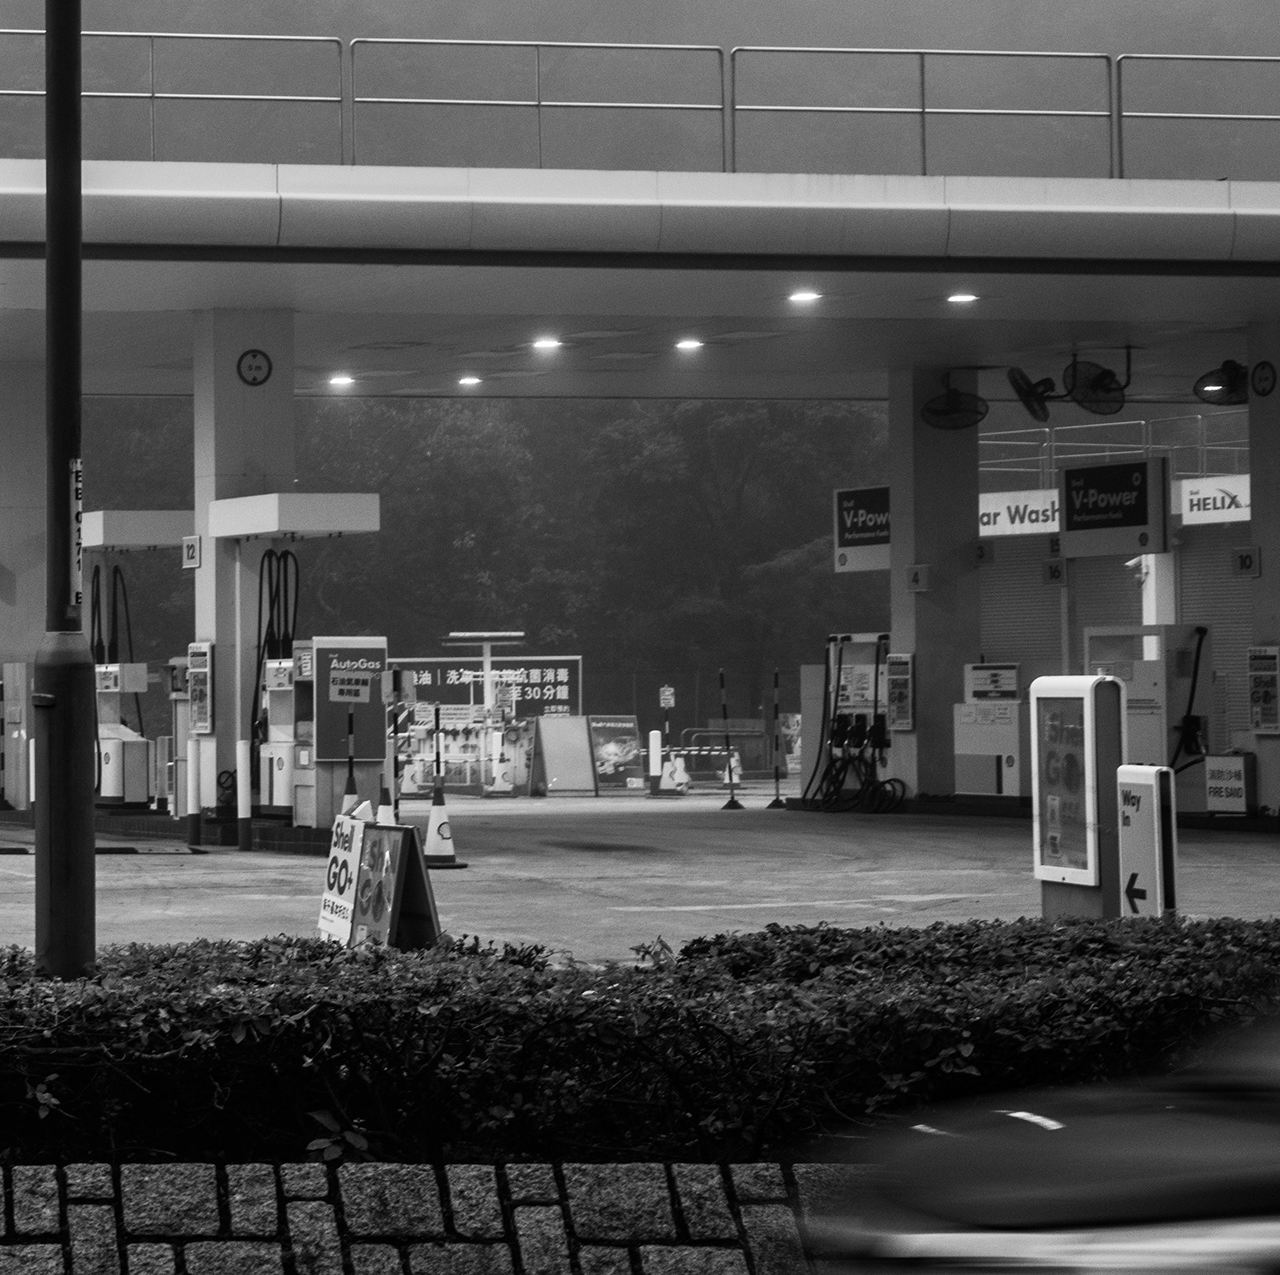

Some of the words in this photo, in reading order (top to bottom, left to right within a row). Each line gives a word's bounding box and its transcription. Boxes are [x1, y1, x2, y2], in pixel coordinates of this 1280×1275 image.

[1071, 487, 1139, 510] V-Power
[1189, 494, 1243, 512] HELIX
[843, 508, 890, 529] V-Pow
[980, 510, 1001, 526] ar
[186, 543, 196, 561] 12
[1238, 553, 1253, 570] 10
[911, 571, 920, 585] 4
[1048, 564, 1061, 580] 16
[330, 658, 382, 670] AutoGas
[1121, 789, 1142, 813] Way
[1208, 786, 1225, 798] FIRE
[1225, 786, 1244, 799] SAND
[1121, 810, 1131, 827] In
[332, 820, 355, 853] Shell
[327, 855, 353, 896] GO+
